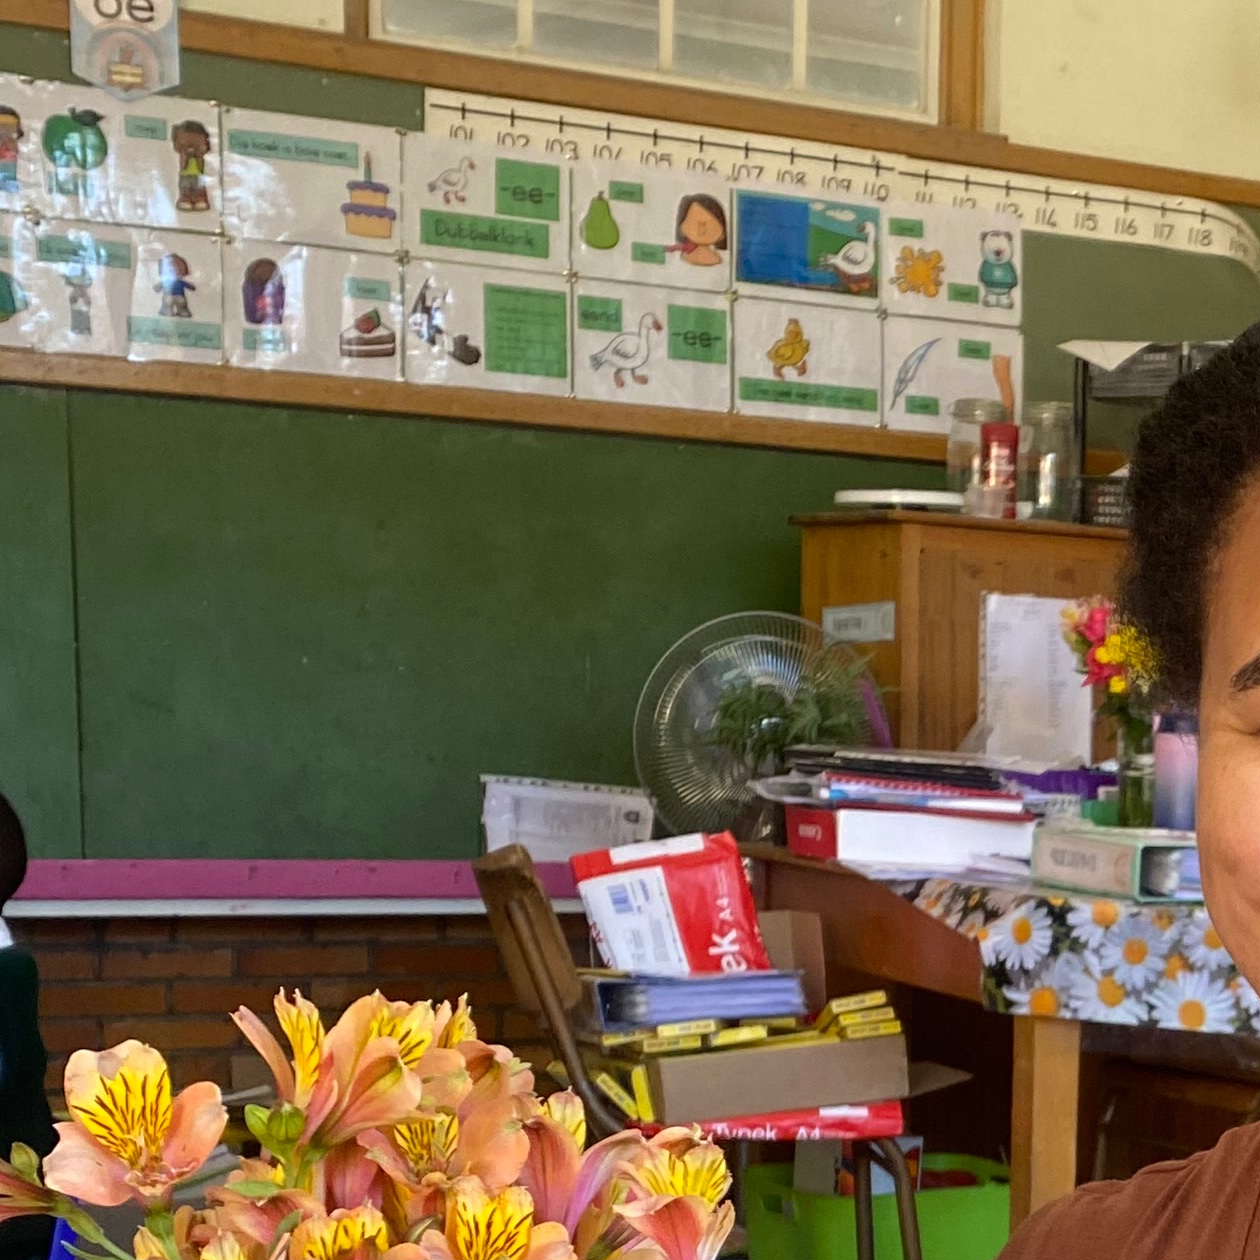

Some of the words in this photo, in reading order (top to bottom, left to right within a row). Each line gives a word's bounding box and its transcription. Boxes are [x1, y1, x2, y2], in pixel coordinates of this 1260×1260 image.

[1035, 207, 1057, 228] 114
[1074, 212, 1099, 232] 115
[1114, 216, 1138, 236] 116
[1153, 222, 1176, 242] 117
[1187, 226, 1213, 247] 118
